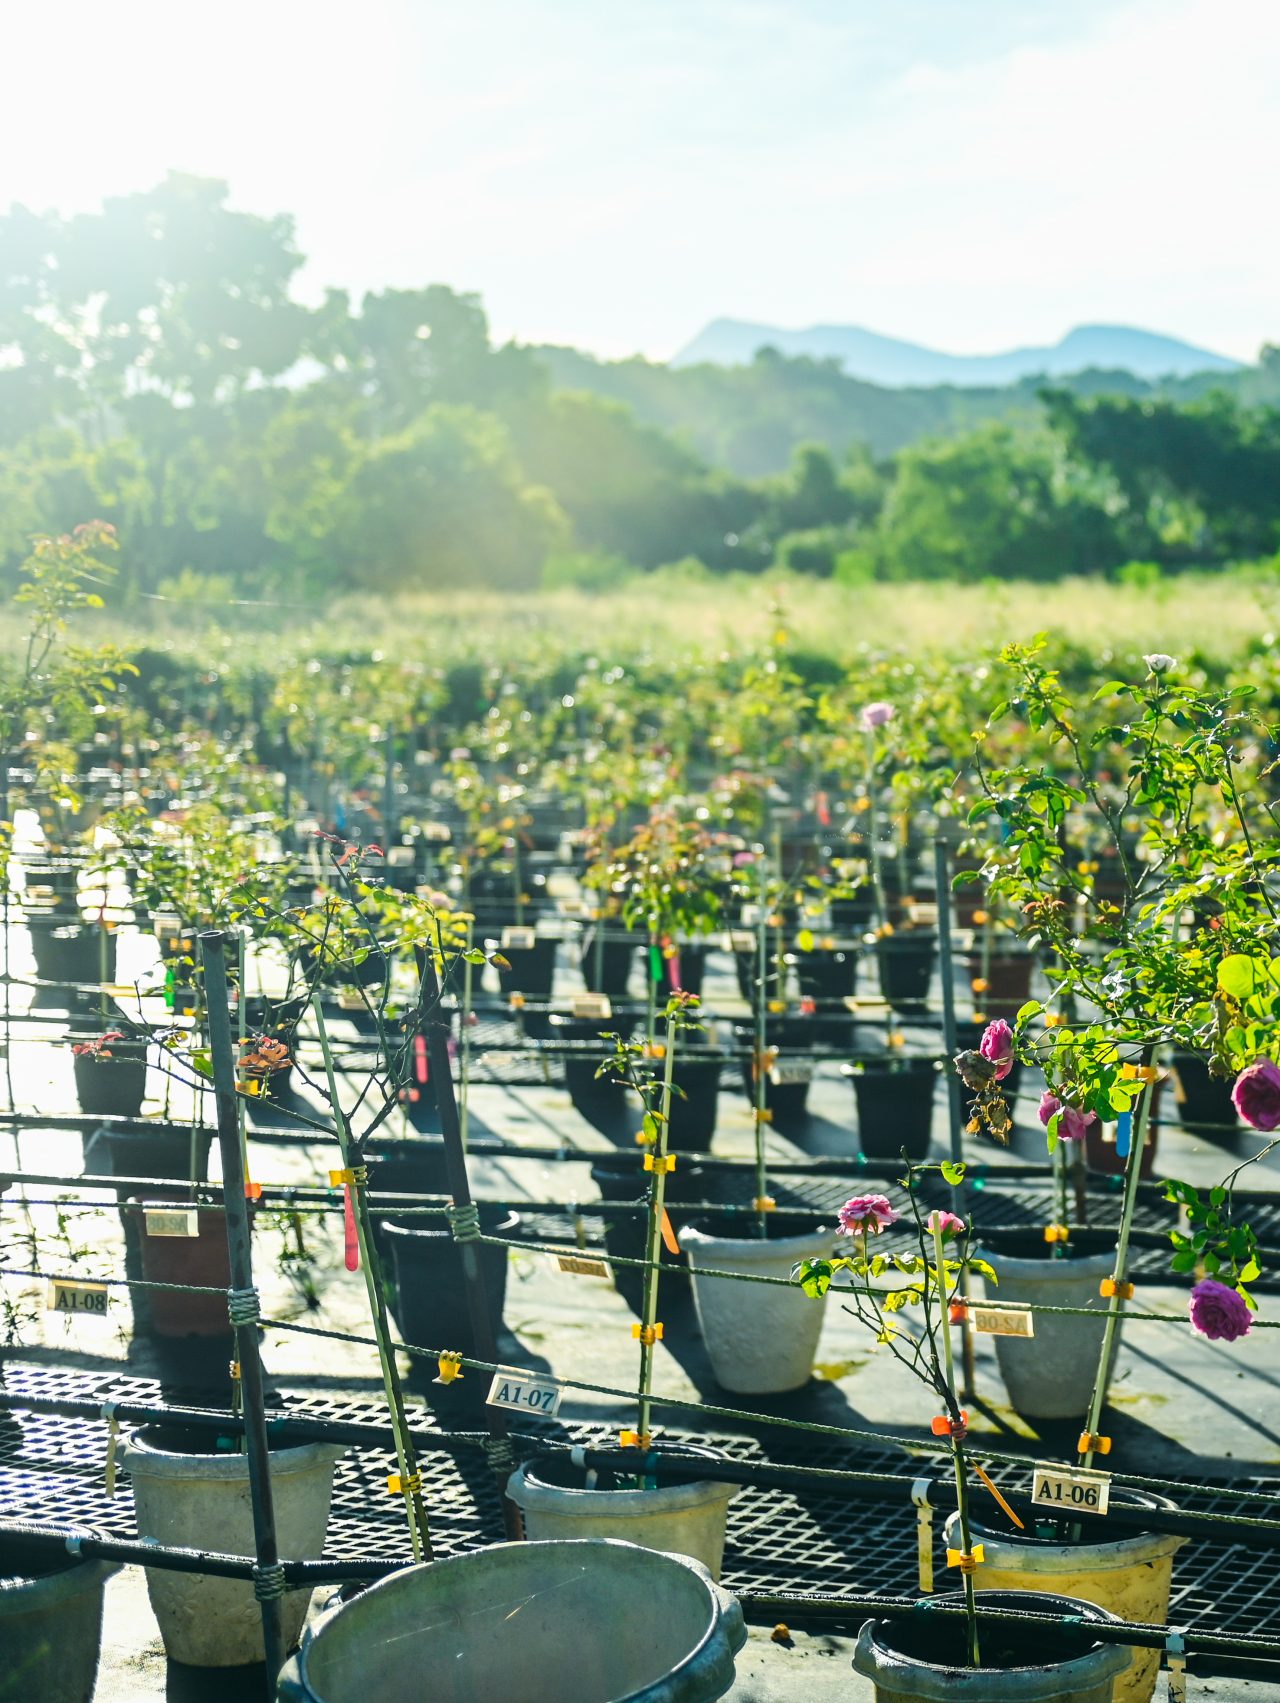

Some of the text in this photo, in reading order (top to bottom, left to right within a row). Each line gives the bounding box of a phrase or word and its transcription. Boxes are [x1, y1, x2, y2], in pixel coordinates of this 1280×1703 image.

[57, 1291, 106, 1314] A1-08
[495, 1383, 556, 1411] A1-07
[1038, 1481, 1098, 1507] A1-06
